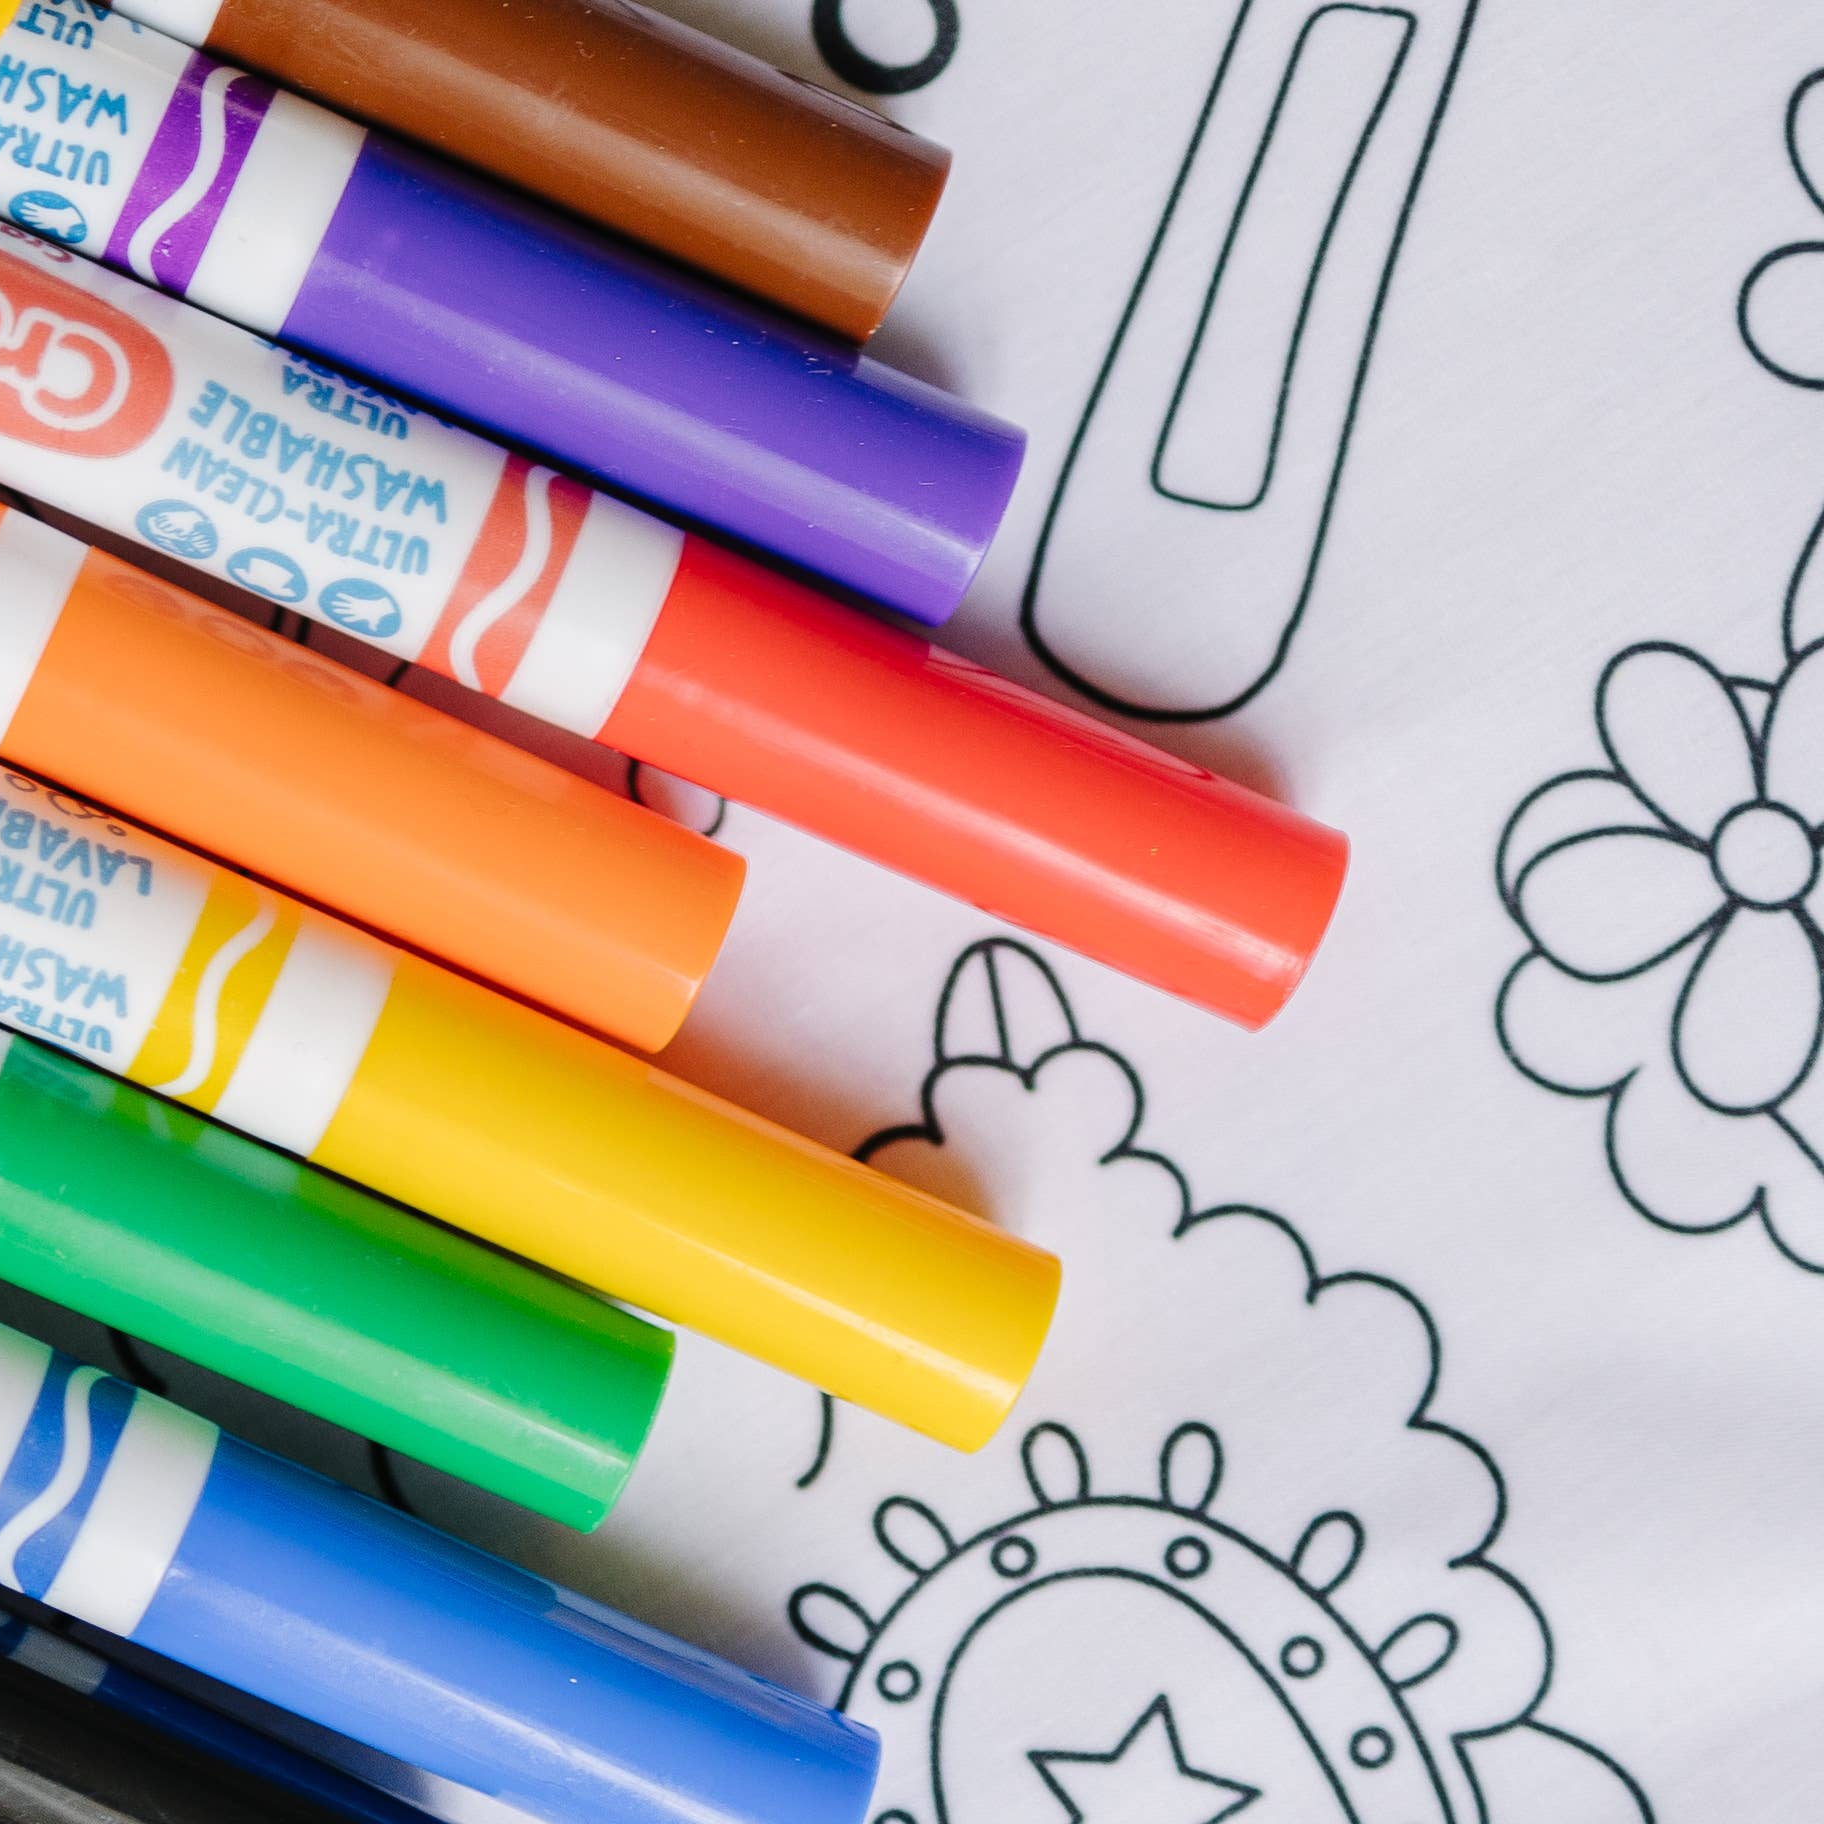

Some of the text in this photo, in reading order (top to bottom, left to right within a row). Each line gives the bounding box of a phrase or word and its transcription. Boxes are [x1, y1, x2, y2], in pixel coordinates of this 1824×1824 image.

[187, 379, 448, 524] WASHABLE
[280, 363, 408, 442] ULTRA
[161, 435, 431, 576] ULTRA-CLEAN
